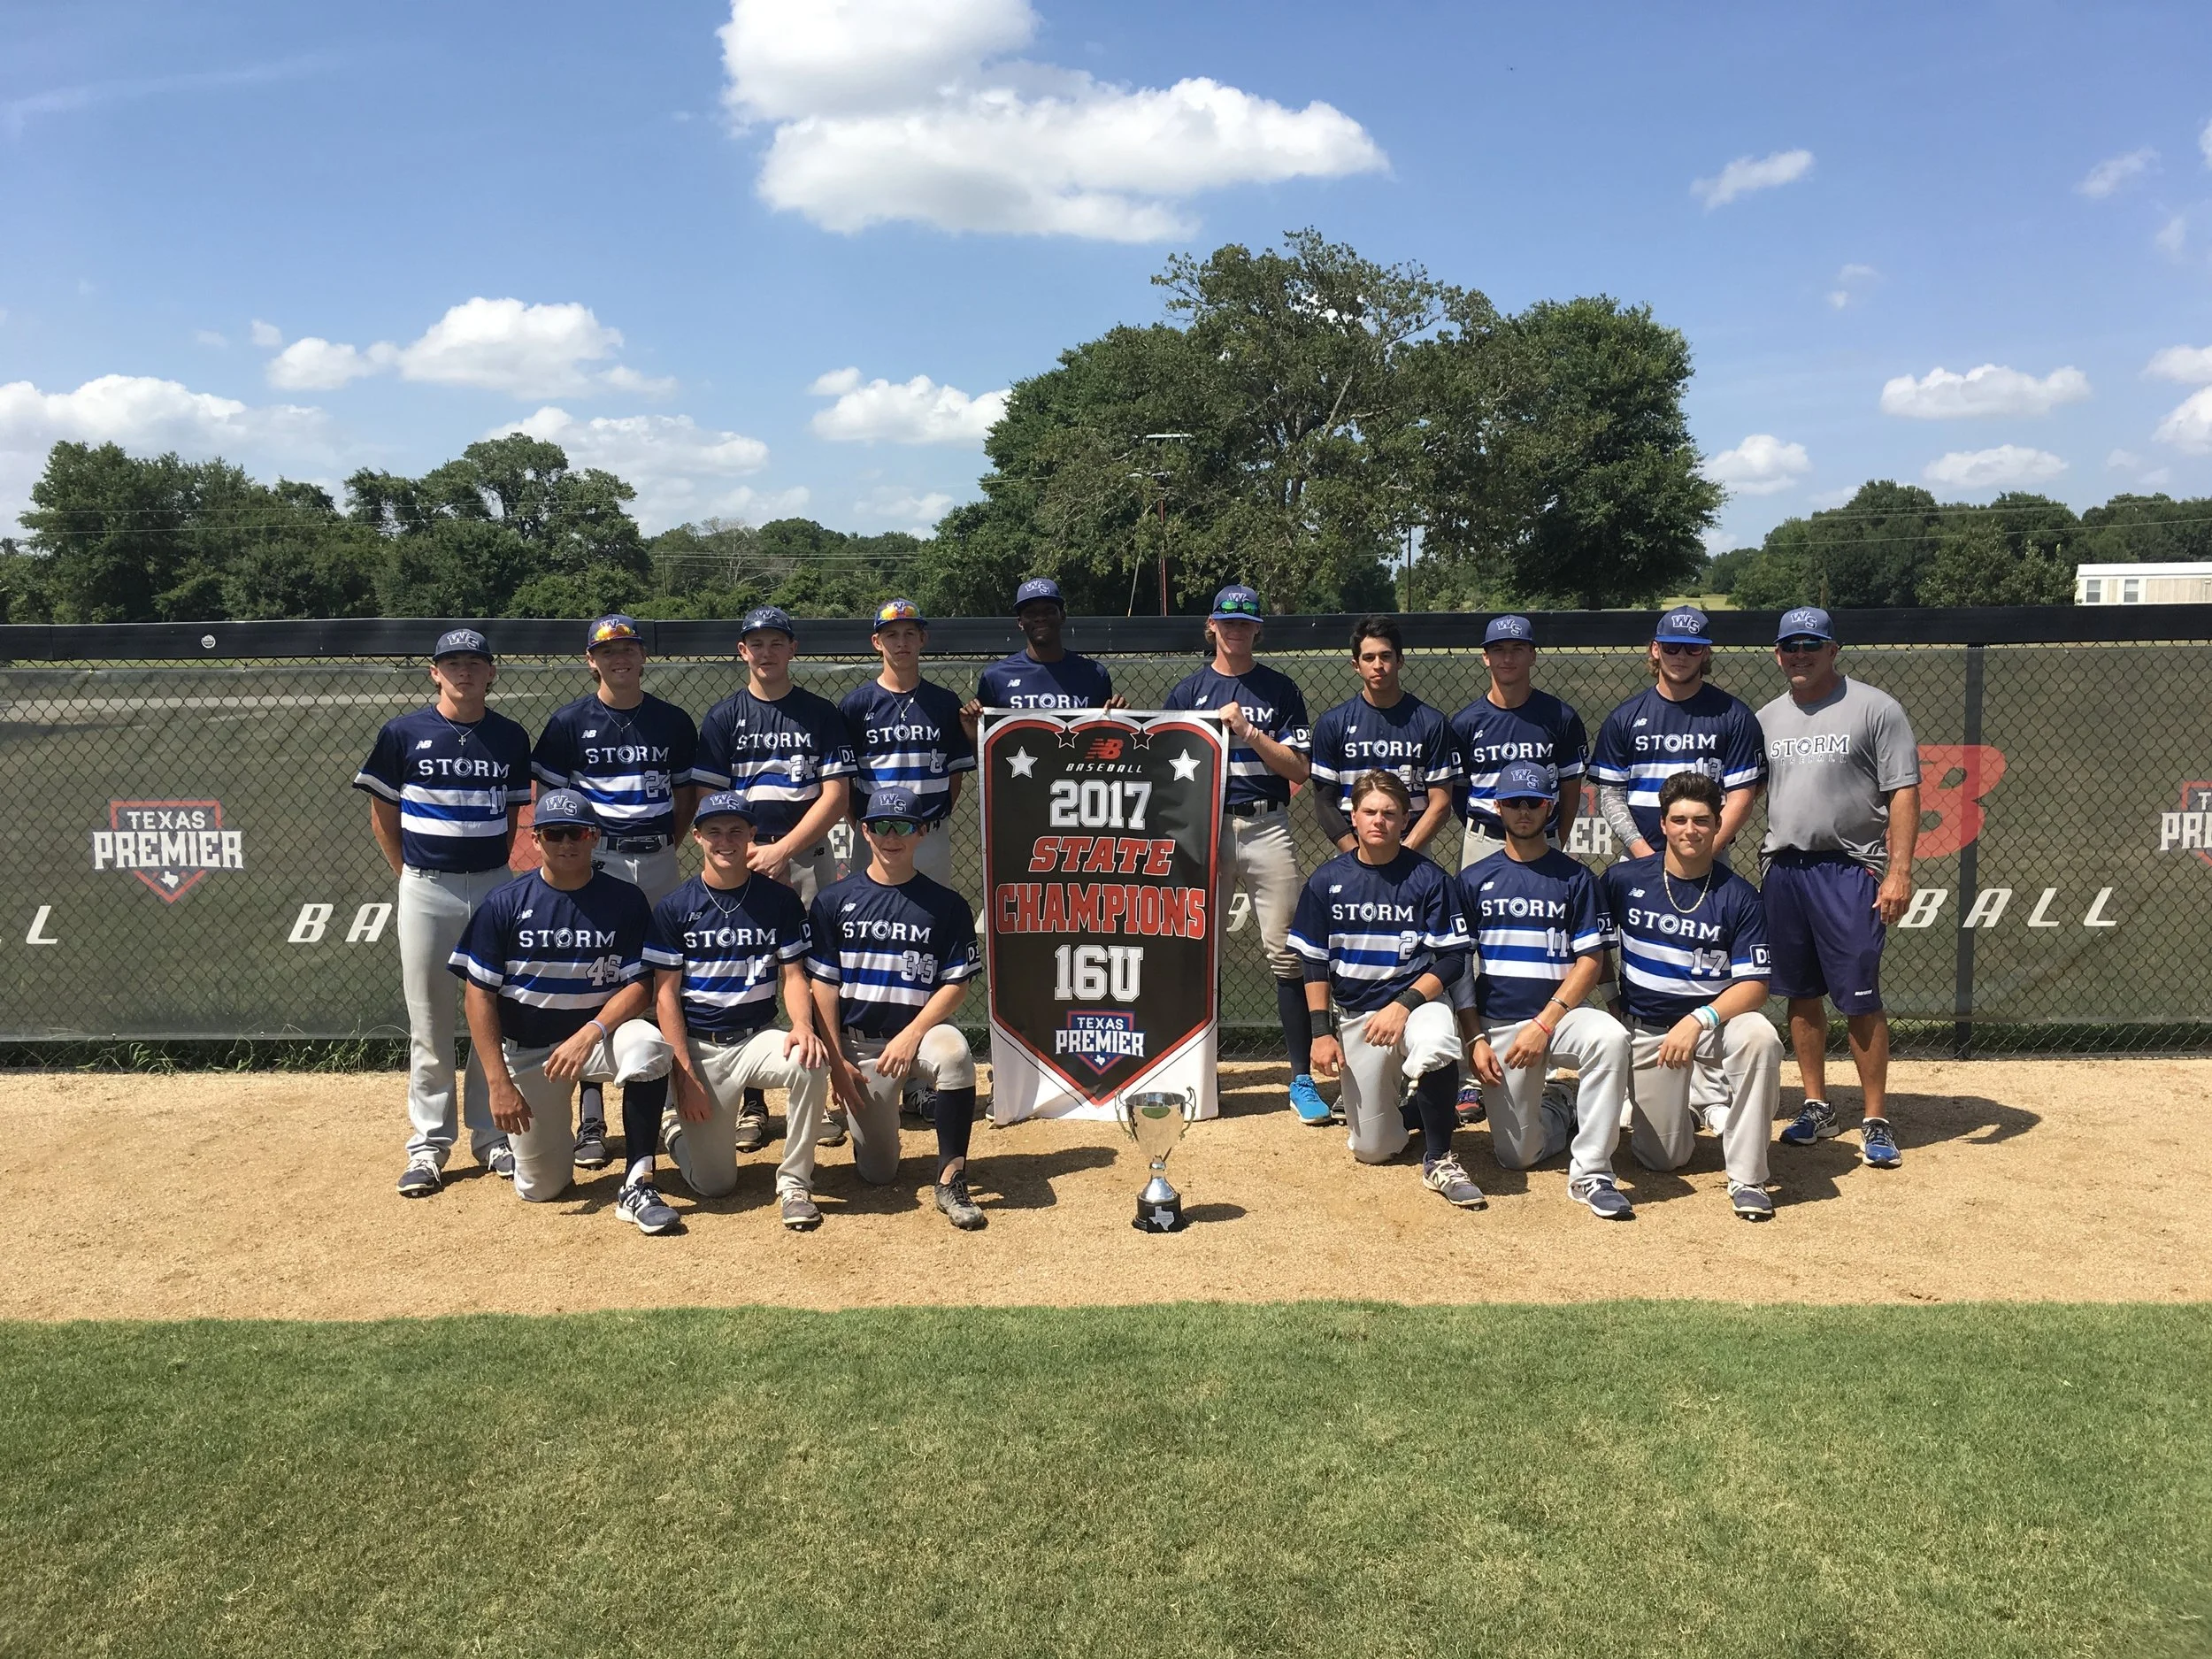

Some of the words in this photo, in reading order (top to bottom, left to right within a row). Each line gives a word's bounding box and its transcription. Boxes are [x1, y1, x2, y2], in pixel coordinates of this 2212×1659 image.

[1025, 580, 1050, 595] WS
[887, 601, 905, 613] W
[1497, 618, 1523, 636] WS
[1671, 614, 1701, 634] WS
[1790, 611, 1818, 629] WS
[447, 631, 480, 649] WS
[1010, 693, 1089, 709] STORM
[415, 739, 433, 750] NB
[581, 729, 597, 739] NB
[736, 732, 812, 750] STORM
[866, 724, 941, 744] STORM
[1635, 733, 1717, 753] STORM
[585, 745, 670, 764] STORM
[1084, 738, 1125, 760] NB
[1344, 741, 1423, 759] STORM
[1473, 741, 1554, 763] STORM
[1770, 733, 1850, 759] STORM
[418, 757, 511, 779] STORM
[1065, 763, 1143, 773] BASEBALL
[1511, 768, 1540, 789] WS
[545, 795, 578, 816] WS
[710, 794, 740, 811] WS
[879, 793, 907, 813] WS
[1049, 779, 1152, 831] 2017
[127, 810, 206, 830] TEXAS
[93, 830, 244, 870] PREMIER
[1028, 835, 1176, 876] STATE
[1328, 884, 1342, 894] NB
[1628, 887, 1645, 898] NB
[995, 882, 1207, 941] CHAMPIONS
[1332, 901, 1414, 923] STORM
[1481, 896, 1566, 920] STORM
[1897, 887, 2117, 928] BALL
[842, 919, 931, 944] STORM
[1627, 908, 1721, 942] STORM
[518, 927, 616, 949] STORM
[683, 926, 776, 949] STORM
[1399, 929, 1418, 961] 2
[1546, 926, 1569, 958] 11
[586, 954, 623, 987] 45
[1692, 947, 1728, 977] 17
[1054, 944, 1144, 1002] 16U
[1077, 1017, 1124, 1030] TEXAS
[1055, 1029, 1147, 1057] PREMIER
